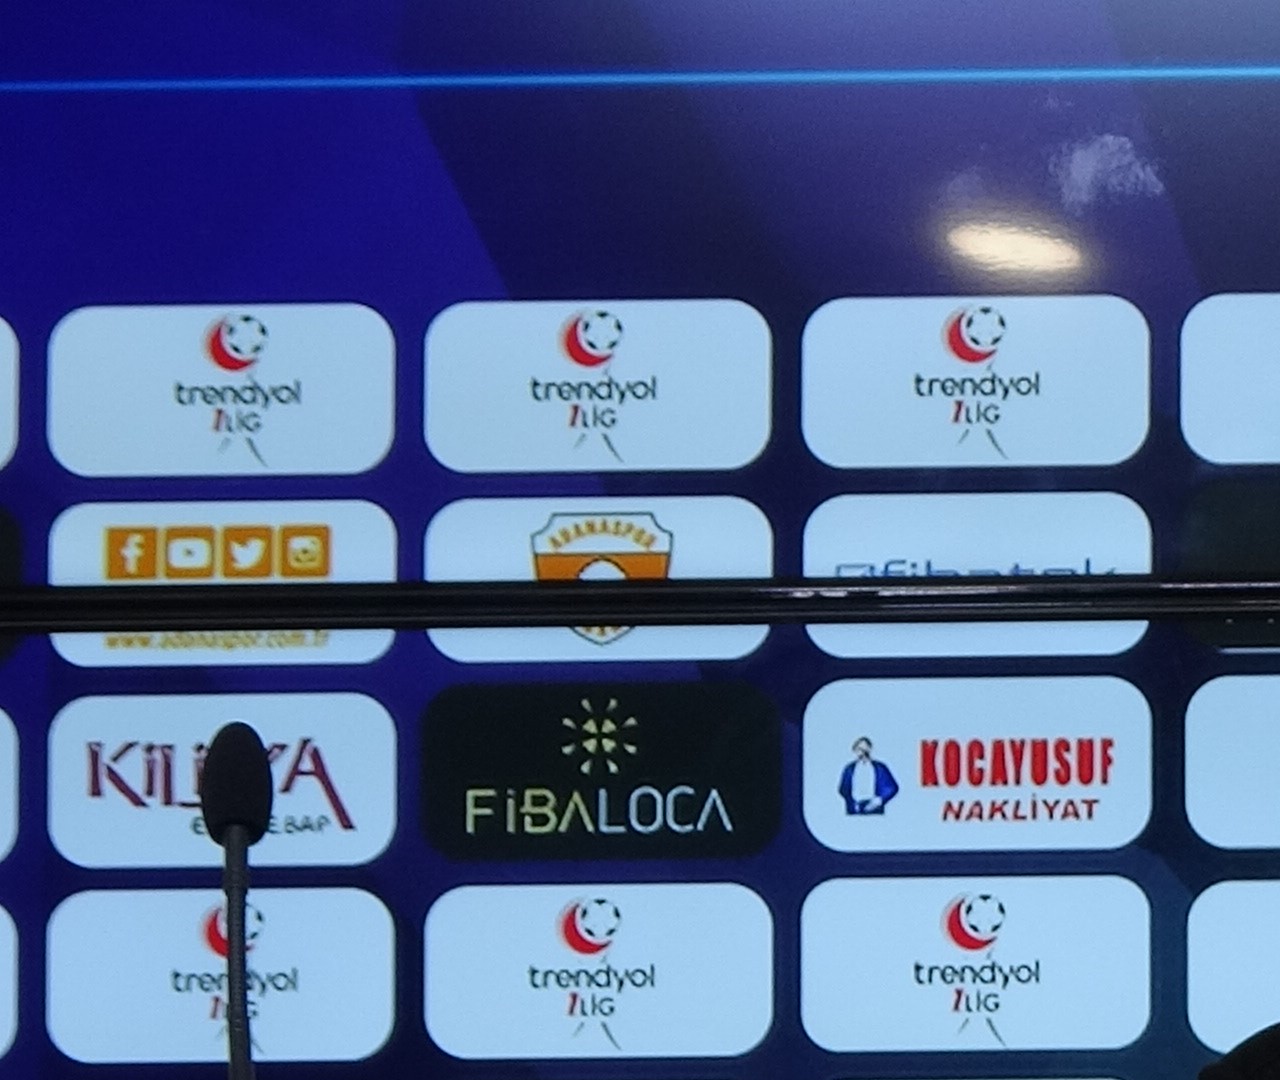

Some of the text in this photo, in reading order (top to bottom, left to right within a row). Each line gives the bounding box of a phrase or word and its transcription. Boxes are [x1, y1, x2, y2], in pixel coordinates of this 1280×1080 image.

[174, 377, 301, 409] trendyol
[530, 374, 656, 405] trendyol
[914, 369, 1040, 401] trendyol
[920, 738, 1114, 788] KOCAYUSUF
[942, 793, 1100, 822] NAKLİYAT
[528, 961, 655, 993] trendyol
[914, 956, 1040, 989] trendyol
